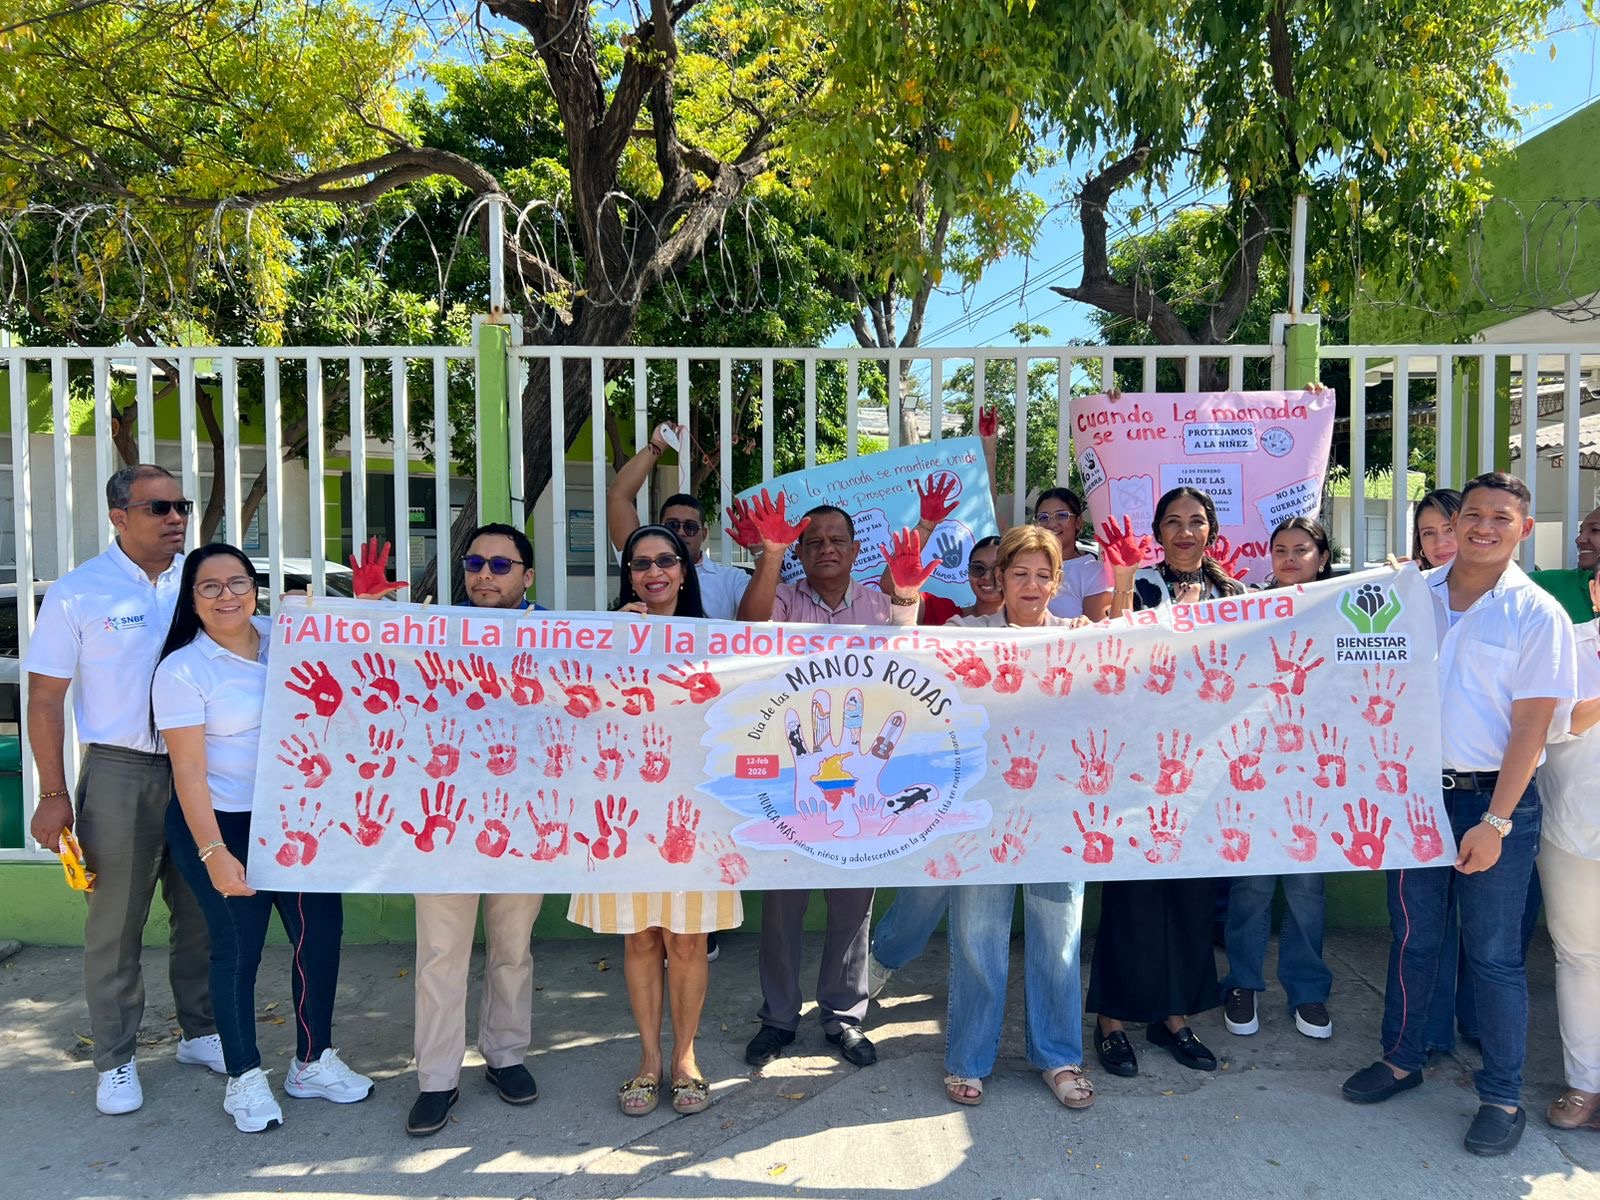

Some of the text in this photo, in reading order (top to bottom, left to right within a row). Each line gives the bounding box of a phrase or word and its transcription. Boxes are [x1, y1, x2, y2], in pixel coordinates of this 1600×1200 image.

[1173, 403, 1198, 422] La
[1211, 400, 1308, 421] manada
[1092, 430, 1115, 446] se
[1187, 428, 1254, 437] PROTEJAMOS
[1194, 439, 1249, 449] A LA NIÑEZ
[805, 478, 822, 498] la
[876, 468, 892, 480] se
[894, 456, 942, 476] mantiene
[1205, 488, 1233, 496] ROJAS
[1275, 490, 1288, 500] NO
[1296, 484, 1307, 492] LA
[1270, 498, 1302, 514] GUERRA
[1270, 512, 1295, 526] NIÑOS
[1295, 509, 1301, 517] Y
[853, 553, 883, 567] GUERRA
[120, 614, 145, 624] SNBF
[380, 615, 448, 646] ahí!
[461, 618, 501, 646] La
[516, 620, 613, 649] niñez
[664, 624, 695, 654] la
[707, 626, 942, 656] adolescencia
[1336, 637, 1407, 648] BIENESTAR
[1337, 649, 1408, 661] FAMILIAR
[760, 707, 776, 721] de
[769, 692, 790, 707] las
[784, 654, 875, 692] MANOS
[881, 660, 952, 716] ROJAS
[746, 757, 769, 765] 12-feb
[747, 767, 767, 775] 2026
[757, 792, 780, 824] NUNCA
[841, 856, 847, 865] y
[849, 847, 900, 862] adolescentes
[900, 843, 911, 851] en
[909, 838, 919, 846] la
[918, 818, 940, 841] guerra
[949, 790, 957, 800] en
